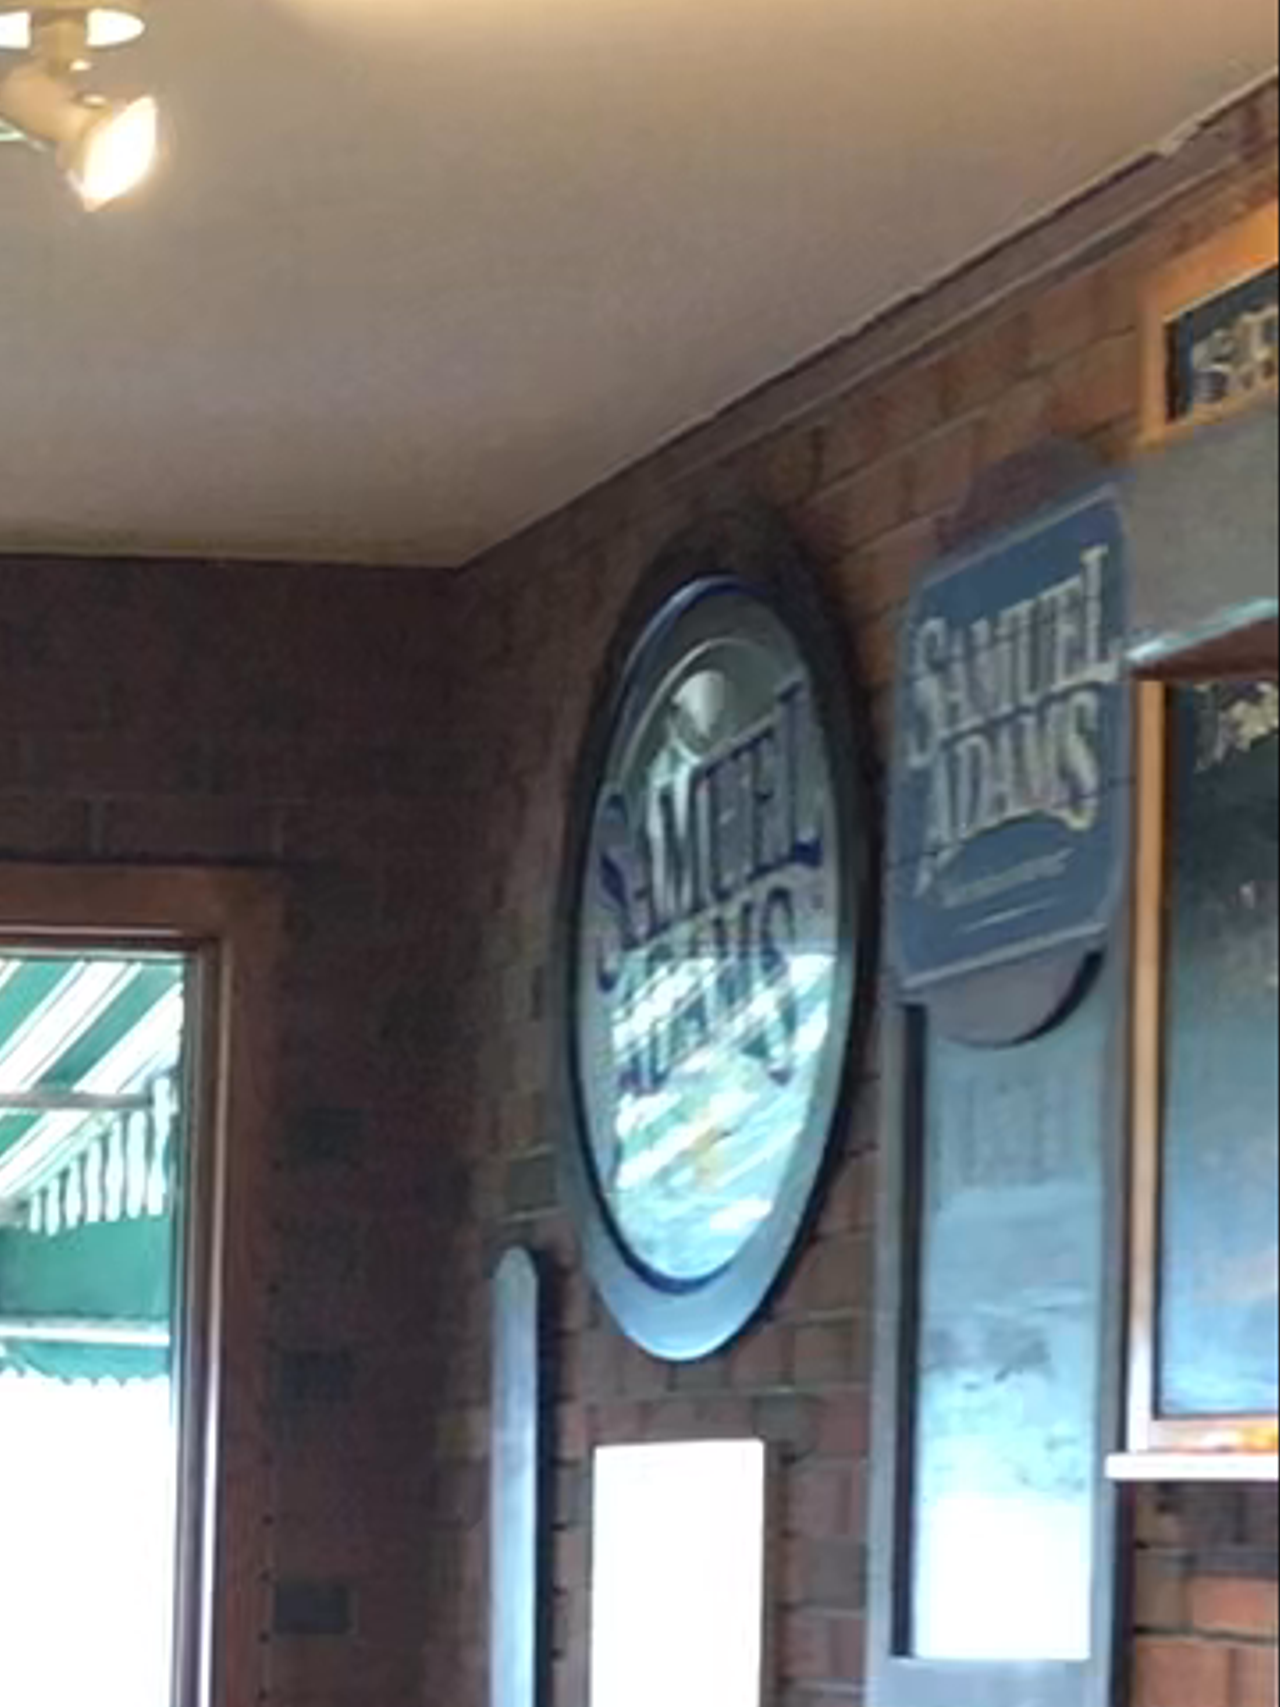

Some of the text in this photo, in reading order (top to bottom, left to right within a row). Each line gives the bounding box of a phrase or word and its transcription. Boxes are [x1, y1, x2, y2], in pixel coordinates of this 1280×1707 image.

[912, 545, 1120, 767] SAMUEL
[598, 679, 824, 993] SAMUEL
[915, 691, 1100, 895] ADAMS
[616, 885, 800, 1093] ADAMS
